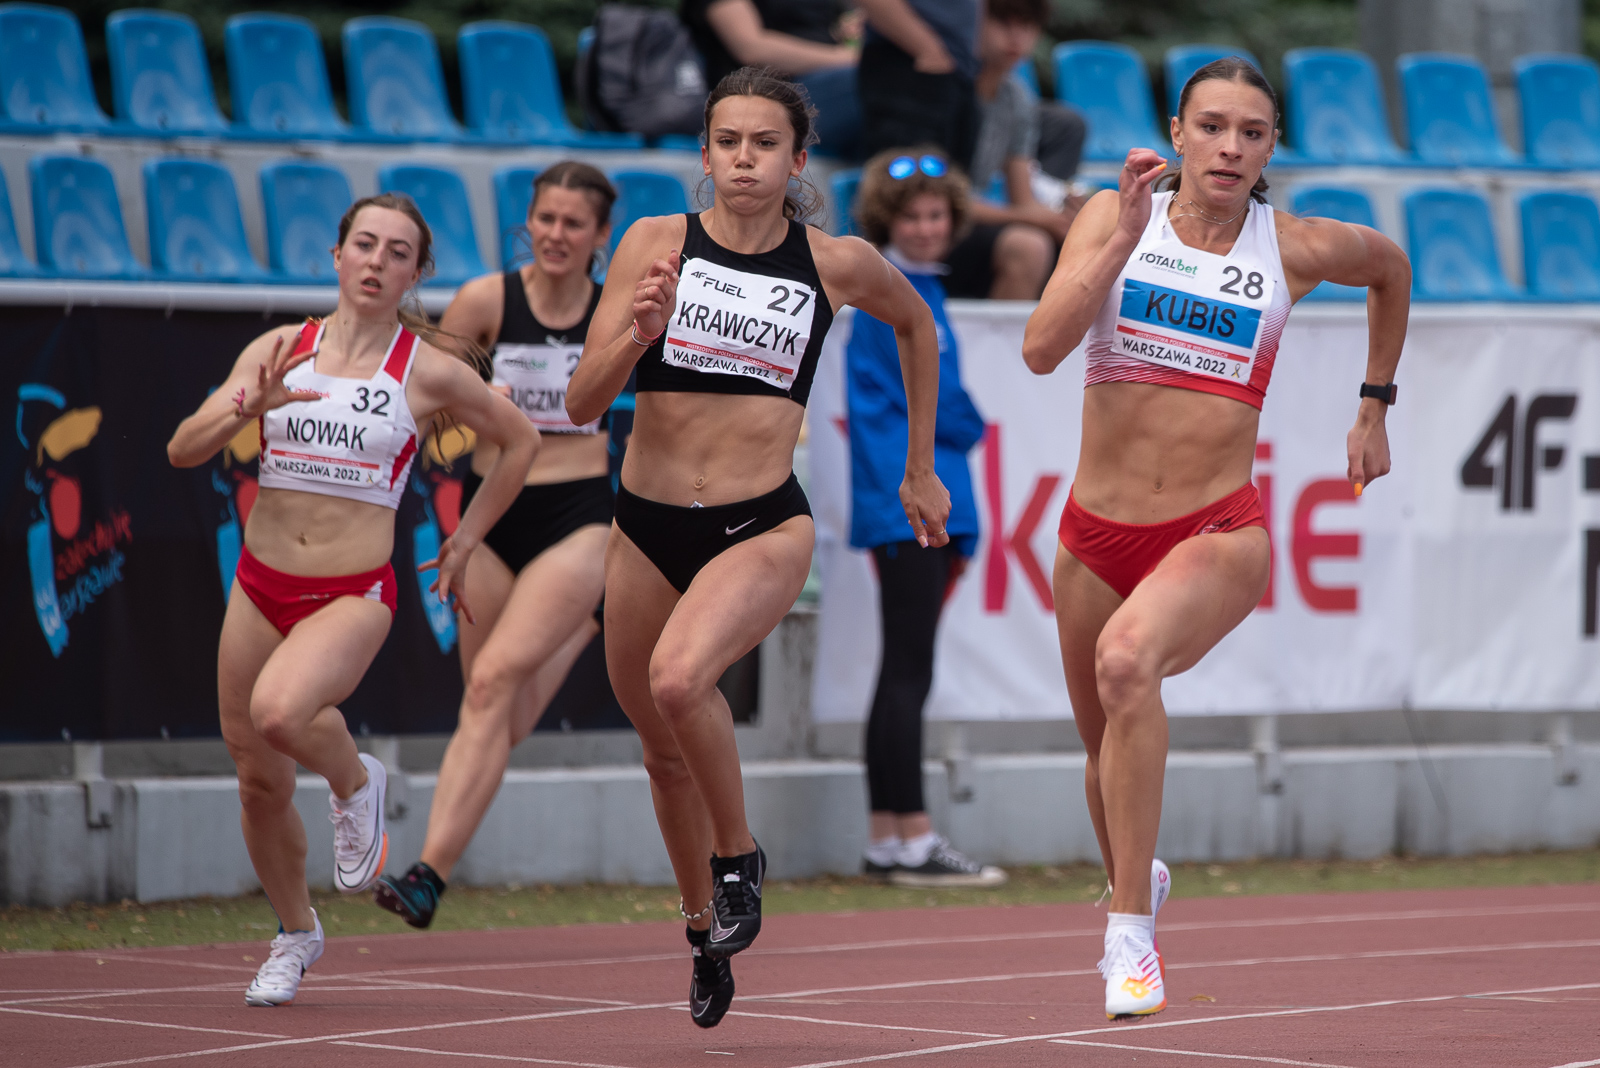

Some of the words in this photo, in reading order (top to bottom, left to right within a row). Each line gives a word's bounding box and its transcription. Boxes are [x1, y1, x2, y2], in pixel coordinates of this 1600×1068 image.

[1139, 252, 1198, 275] TOTALbet
[703, 276, 747, 299] FUEL
[1219, 265, 1264, 300] 28
[767, 285, 811, 317] 27
[1144, 290, 1237, 338] KUBIS
[677, 301, 800, 356] KRAWCZYK
[672, 348, 739, 373] WARSZAWA
[742, 365, 770, 379] 2022
[1122, 337, 1191, 367] WARSZAWA
[1195, 356, 1226, 375] 2022
[351, 386, 391, 417] 32
[286, 416, 368, 451] NOWAK
[1460, 394, 1579, 511] 4F
[274, 458, 330, 478] WARSZAWA
[334, 467, 361, 482] 2022
